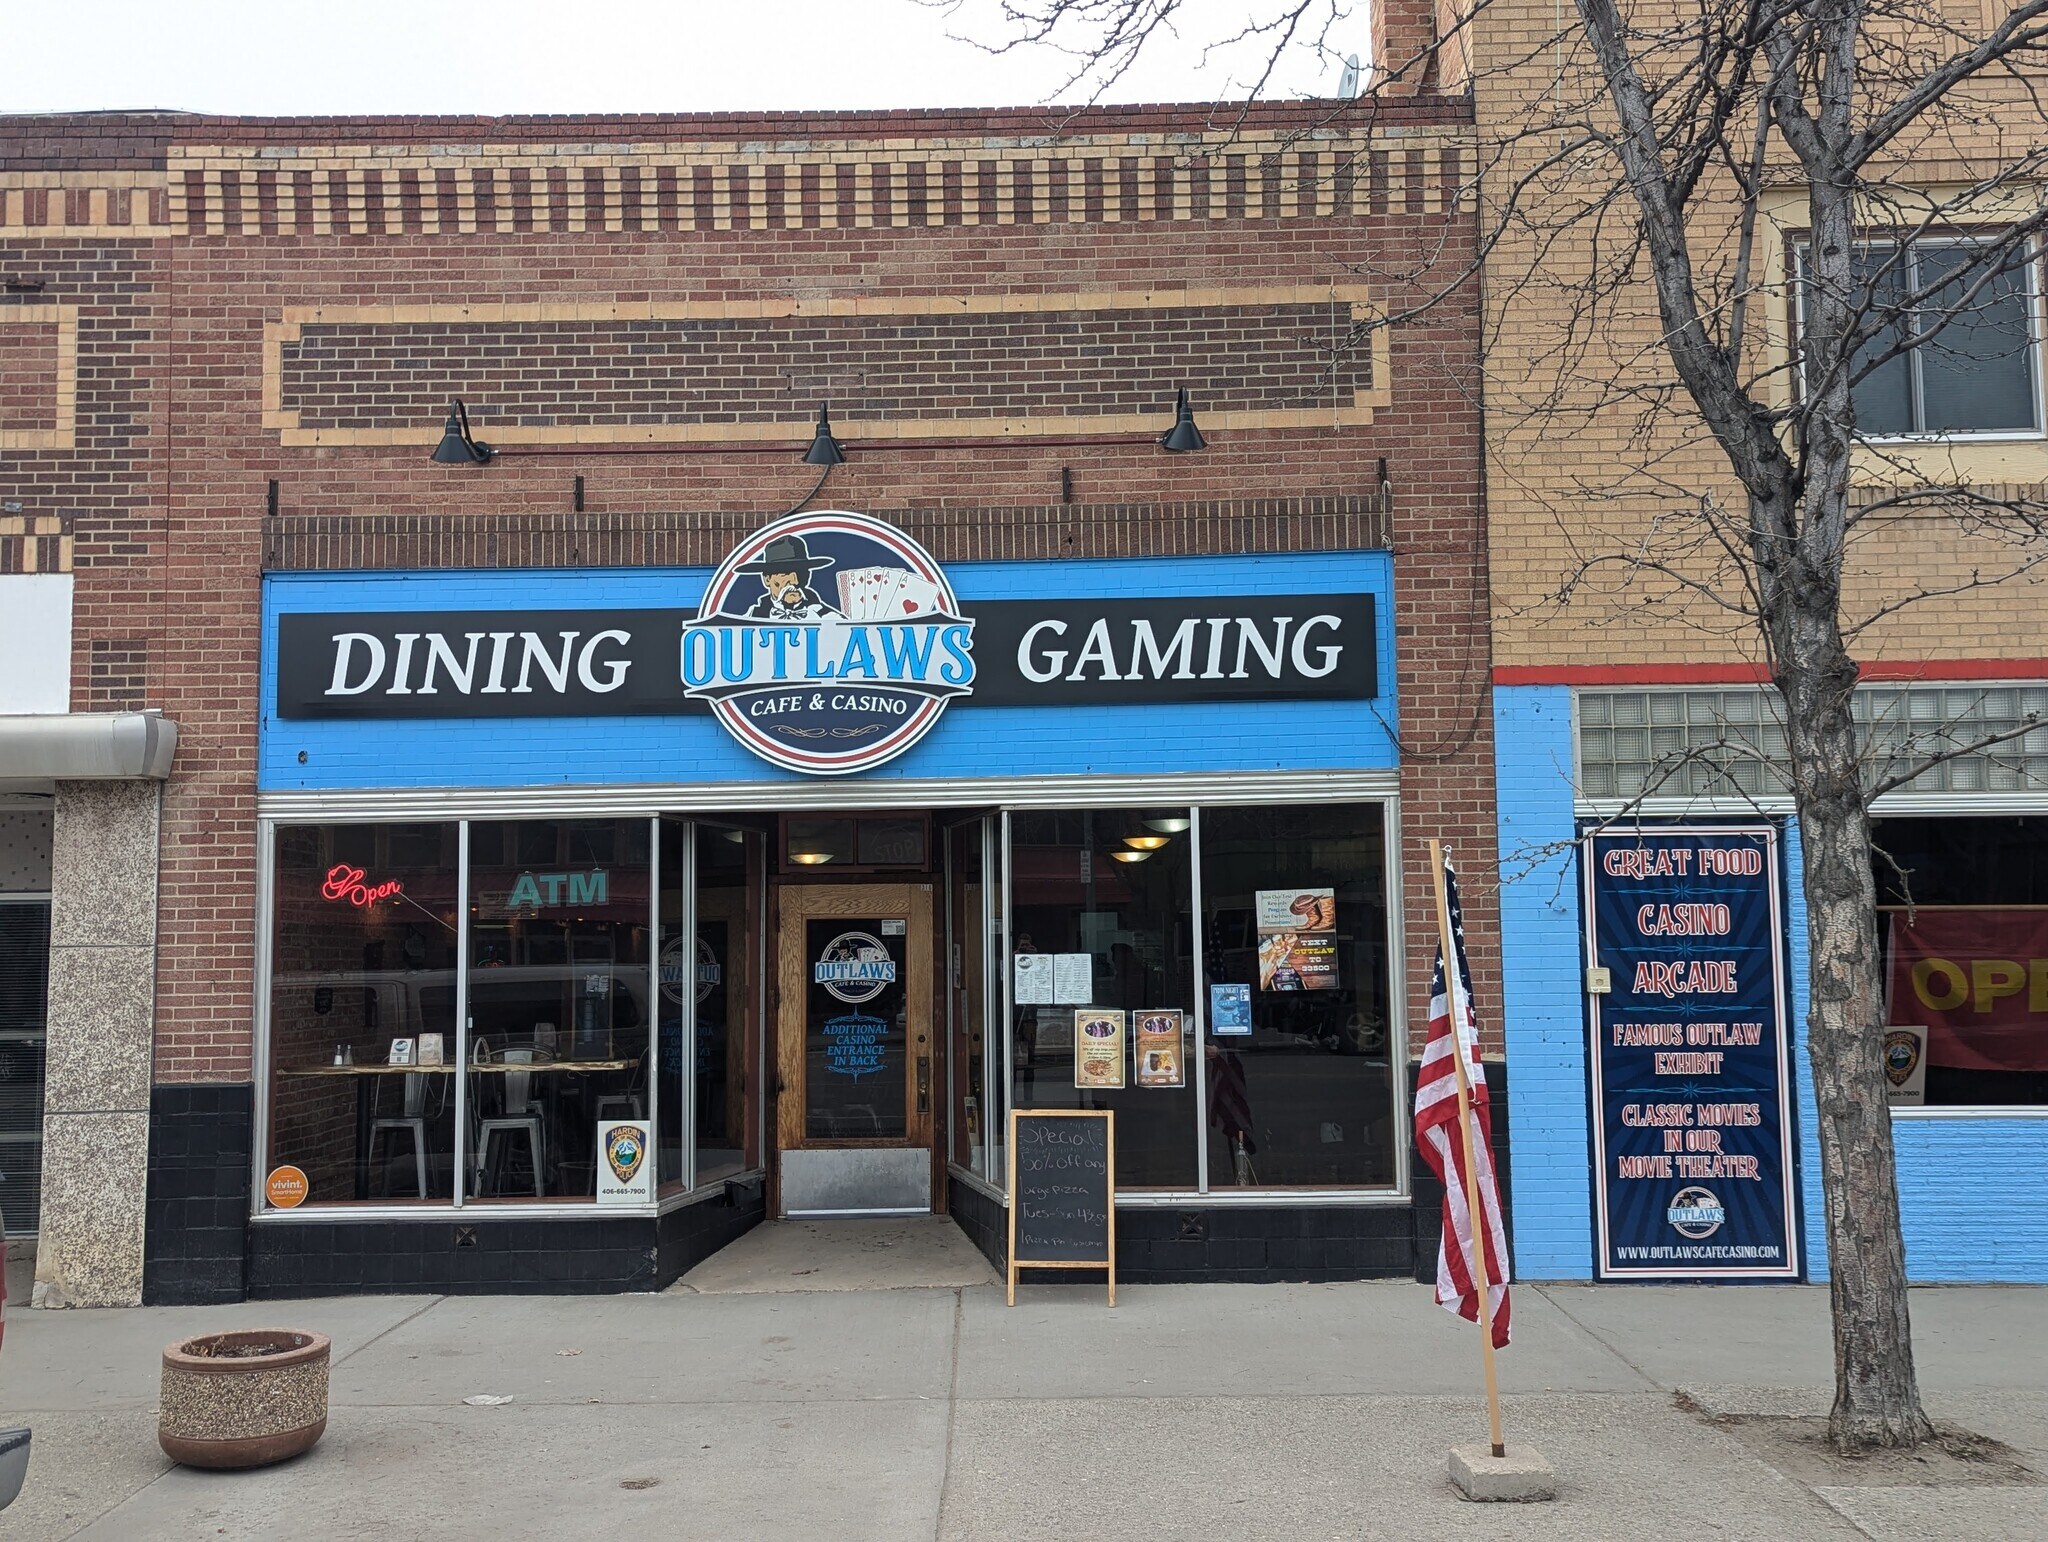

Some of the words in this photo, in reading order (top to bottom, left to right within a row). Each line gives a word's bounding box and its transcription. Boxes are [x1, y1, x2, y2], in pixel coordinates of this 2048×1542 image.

[683, 625, 974, 686] OUTLAWS
[1017, 614, 1343, 683] GAMING
[324, 629, 632, 695] DINING
[750, 695, 802, 717] CAFE
[808, 693, 824, 711] &
[831, 694, 907, 715] CASINO
[1604, 849, 1692, 880] GREAT
[1698, 849, 1761, 876] FOOD
[351, 881, 400, 908] Open
[509, 873, 607, 906] ATM
[1637, 904, 1731, 936] CASINO
[816, 962, 895, 980] OUTLAWS
[1632, 961, 1738, 998] ARCADE
[822, 1025, 889, 1035] ADDITIONAL
[836, 1035, 876, 1045] CASINO
[1613, 1023, 1683, 1046] FAMOUS
[1686, 1023, 1763, 1045] OUTLAW
[827, 1046, 885, 1055] ENTRANCE
[834, 1056, 846, 1065] IN
[849, 1056, 878, 1065] BACK
[1654, 1052, 1724, 1075] EXHIBIT
[1622, 1104, 1694, 1127] CLASSIC
[1697, 1104, 1761, 1126] MOVIES
[611, 1127, 640, 1139] HARDIN
[1664, 1130, 1683, 1153] IN
[1685, 1130, 1724, 1155] OUR
[1619, 1156, 1673, 1179] MOVIE
[1675, 1156, 1762, 1181] THEATER
[1668, 1209, 1725, 1222] OUTLAWS
[1617, 1246, 1780, 1260] WWW.OUTLAWSCAFECASINO.COM
